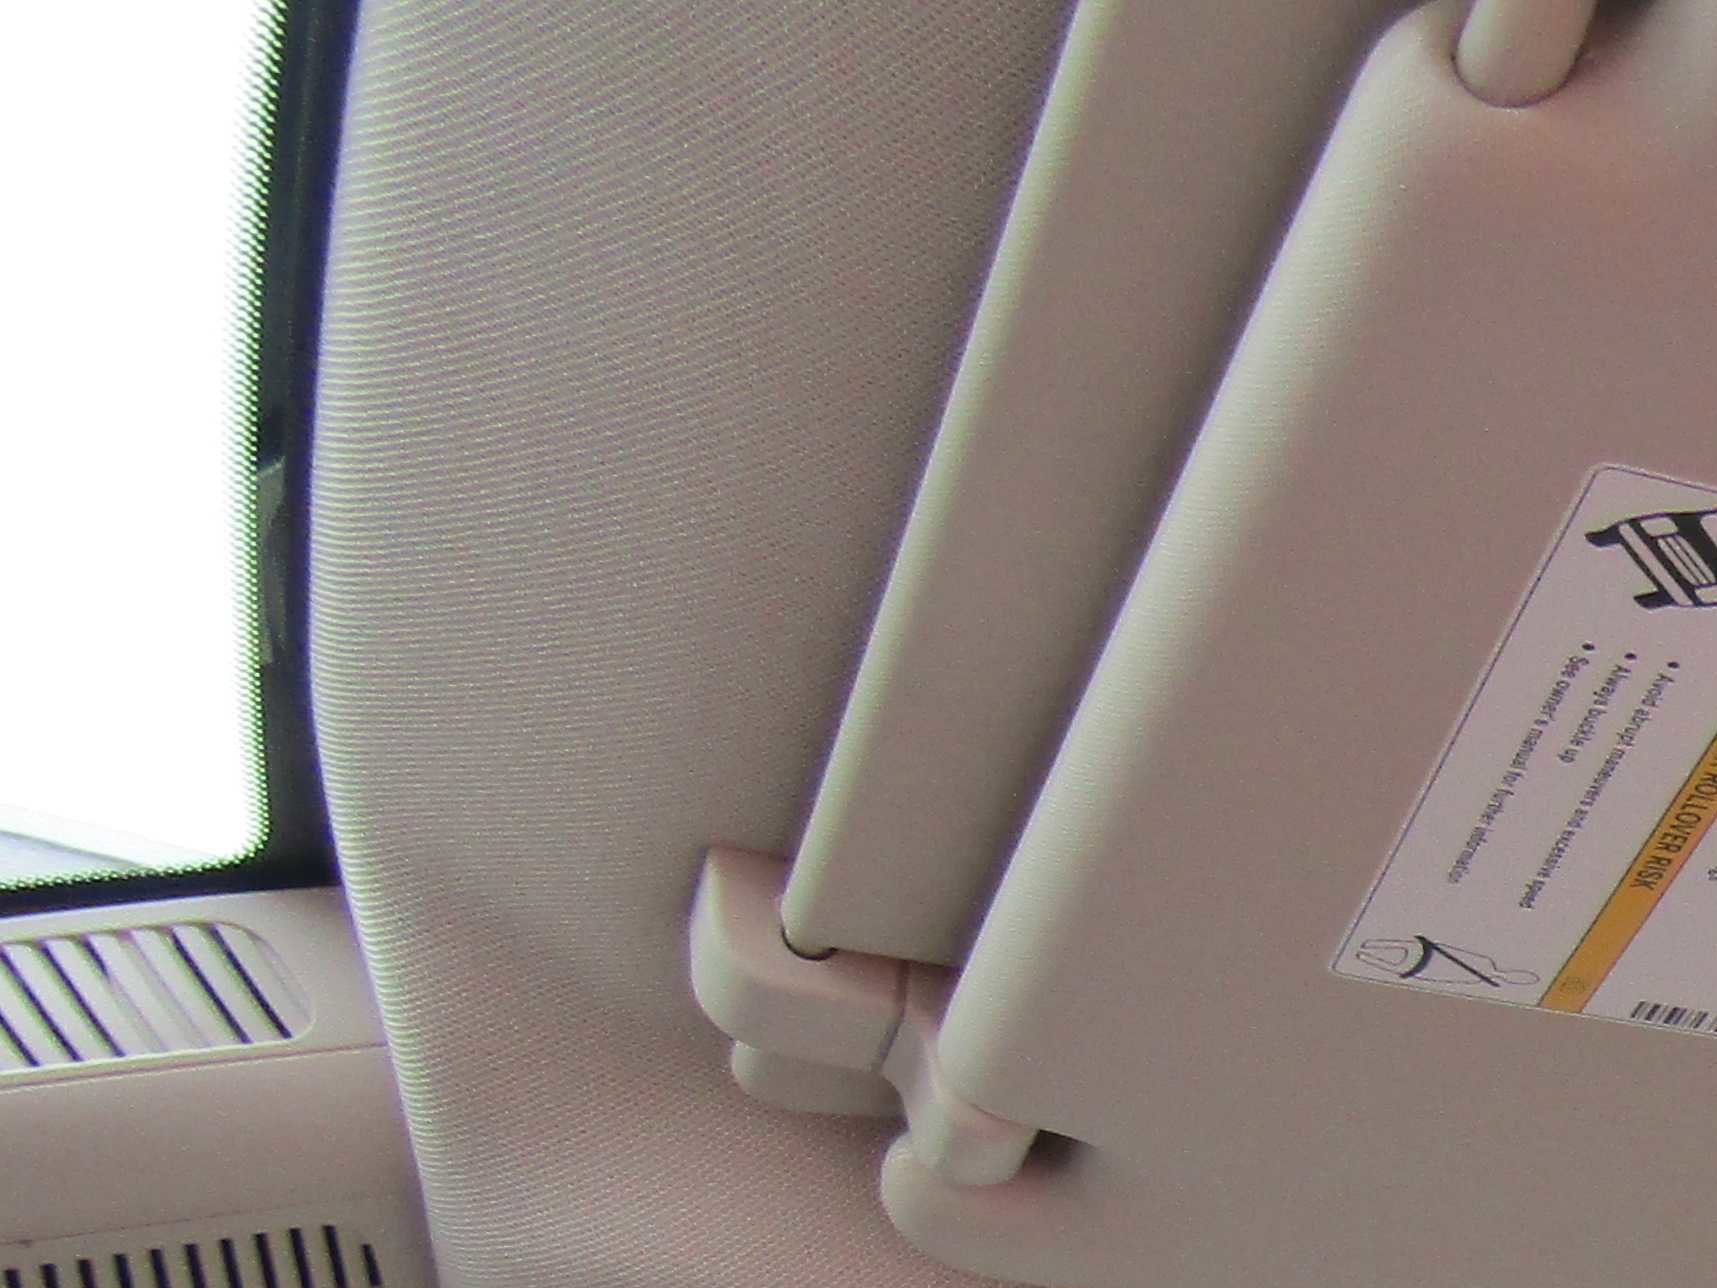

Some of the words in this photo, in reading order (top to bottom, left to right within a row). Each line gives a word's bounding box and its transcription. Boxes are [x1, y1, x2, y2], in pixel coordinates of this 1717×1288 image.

[1560, 655, 1590, 679] See
[1588, 663, 1632, 707] Always
[1533, 679, 1576, 727] owner's
[1639, 673, 1676, 707] Avoid
[1568, 707, 1607, 747] buckle
[1611, 707, 1653, 746] abrupt
[1509, 728, 1548, 770] manual
[1554, 746, 1579, 764] up
[1499, 770, 1524, 788] for
[1578, 748, 1627, 807] maneuvers
[1477, 788, 1514, 826] further
[1565, 808, 1592, 829] and
[1445, 826, 1492, 884] information
[1535, 829, 1578, 878] excessive
[1629, 854, 1674, 891] RISK
[1514, 879, 1549, 909] speed
